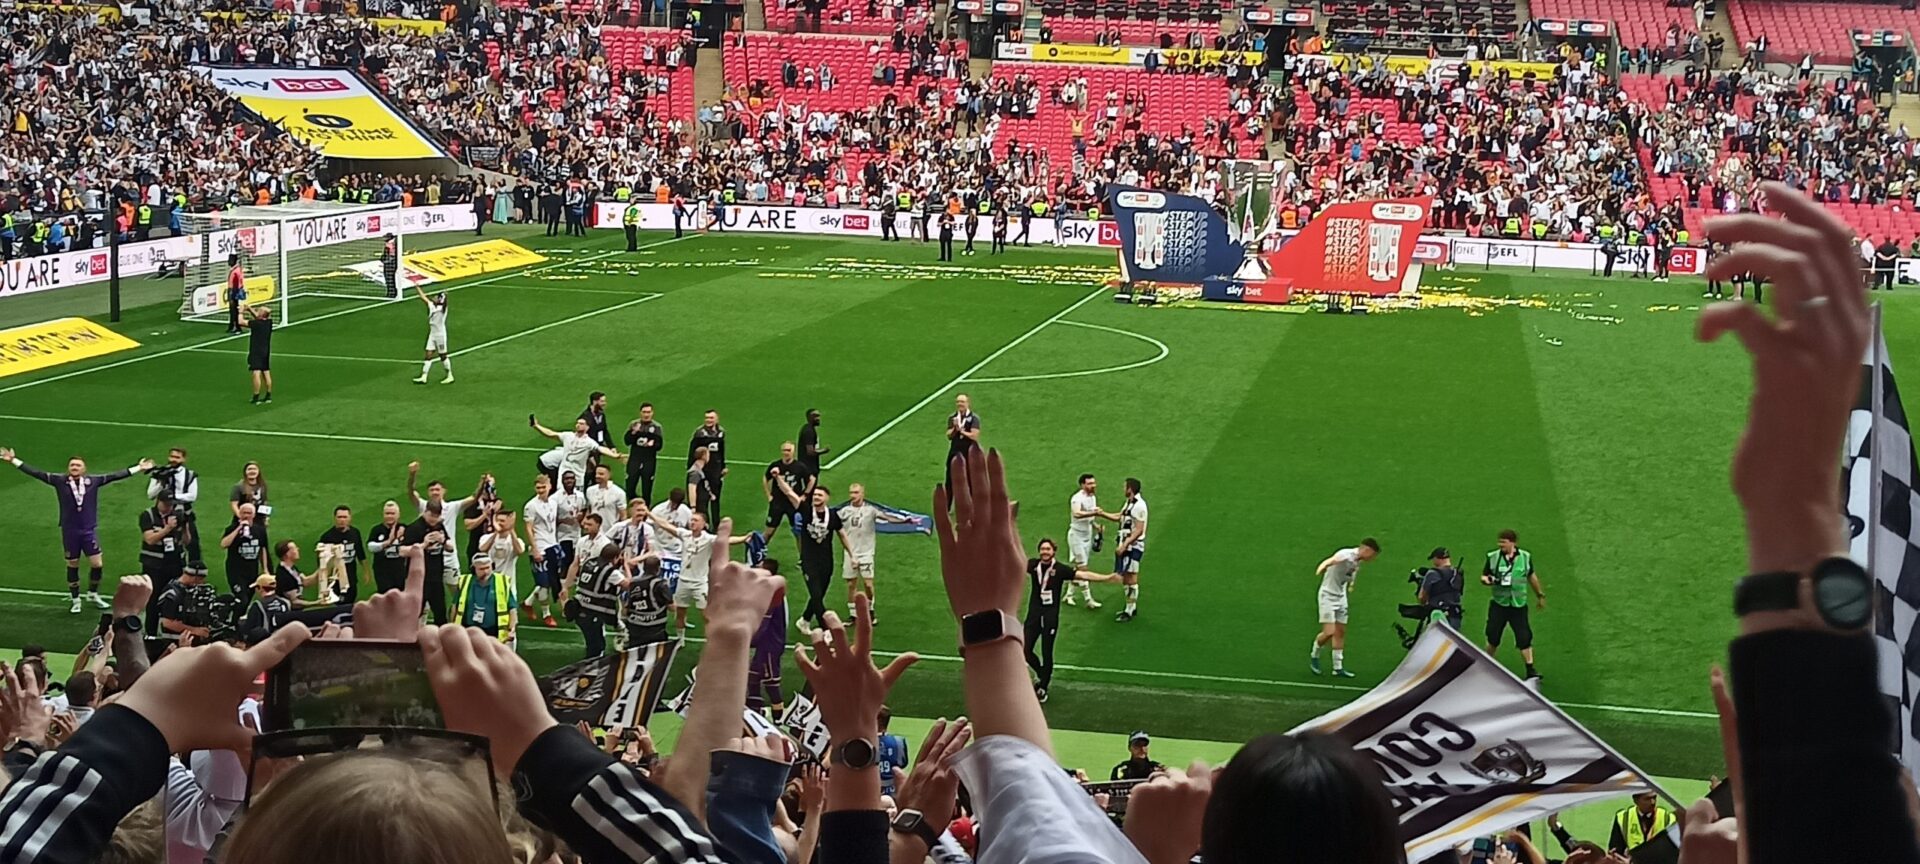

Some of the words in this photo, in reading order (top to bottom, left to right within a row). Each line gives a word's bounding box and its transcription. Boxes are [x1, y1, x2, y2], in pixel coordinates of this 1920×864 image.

[216, 77, 269, 91] sky
[284, 78, 341, 91] bet
[432, 213, 446, 223] EFL
[747, 209, 796, 229] ARE
[820, 214, 841, 228] sky
[845, 215, 868, 227] bet
[295, 221, 323, 246] YOU
[325, 217, 347, 241] ARE
[1063, 223, 1095, 242] sky
[1501, 248, 1518, 257] EFL
[1616, 248, 1650, 269] sky
[1671, 252, 1692, 267] et
[25, 257, 60, 290] ARE
[75, 260, 88, 276] sky
[91, 257, 106, 273] bet
[1227, 285, 1243, 297] sky
[1245, 286, 1262, 295] bet
